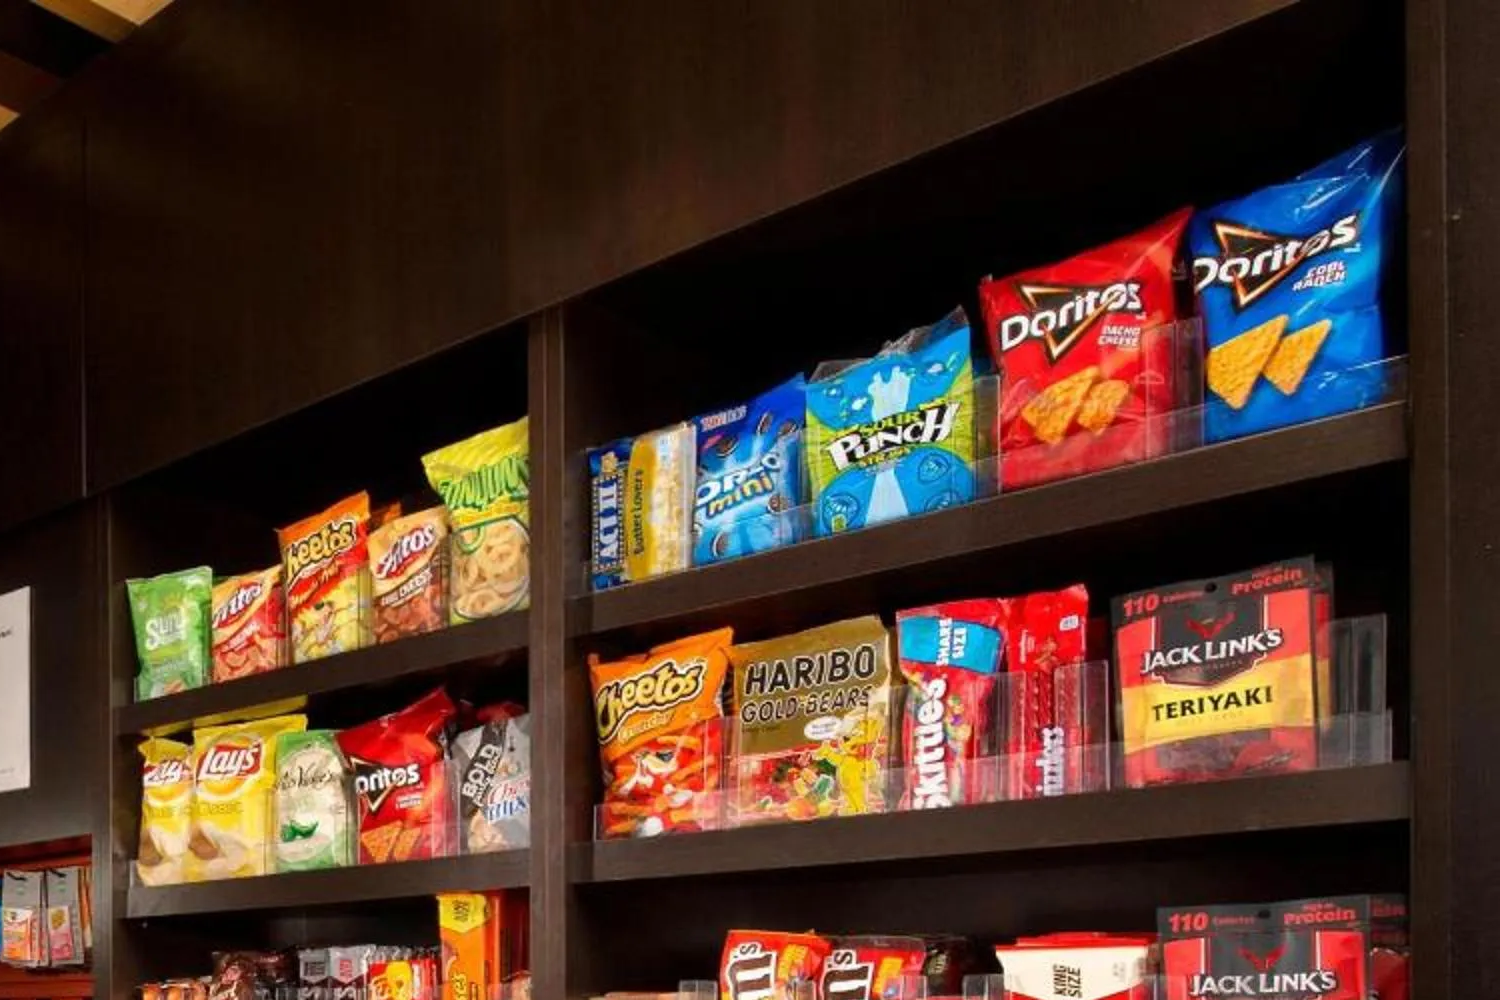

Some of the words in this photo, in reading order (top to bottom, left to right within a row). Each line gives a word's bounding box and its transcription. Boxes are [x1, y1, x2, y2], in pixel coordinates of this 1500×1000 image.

[1193, 214, 1360, 293] Doritos
[1001, 281, 1142, 351] Doritos
[286, 519, 357, 578] heetos
[1123, 594, 1160, 617] 110
[1231, 567, 1303, 596] Protein
[936, 618, 953, 666] SHARE
[952, 628, 967, 659] SIZE
[1140, 643, 1203, 674] JACK
[1204, 627, 1284, 661] LINK'S
[744, 645, 876, 696] HARIBO
[598, 659, 705, 743] Cheetos
[1152, 685, 1274, 722] TERIYAKI
[355, 763, 421, 795] oritos
[1169, 911, 1209, 933] 110
[1284, 908, 1357, 926] Protein
[1053, 964, 1068, 997] KING
[1068, 966, 1083, 998] SIZE
[1190, 974, 1256, 996] JACK
[1258, 970, 1337, 994] LINK'S
